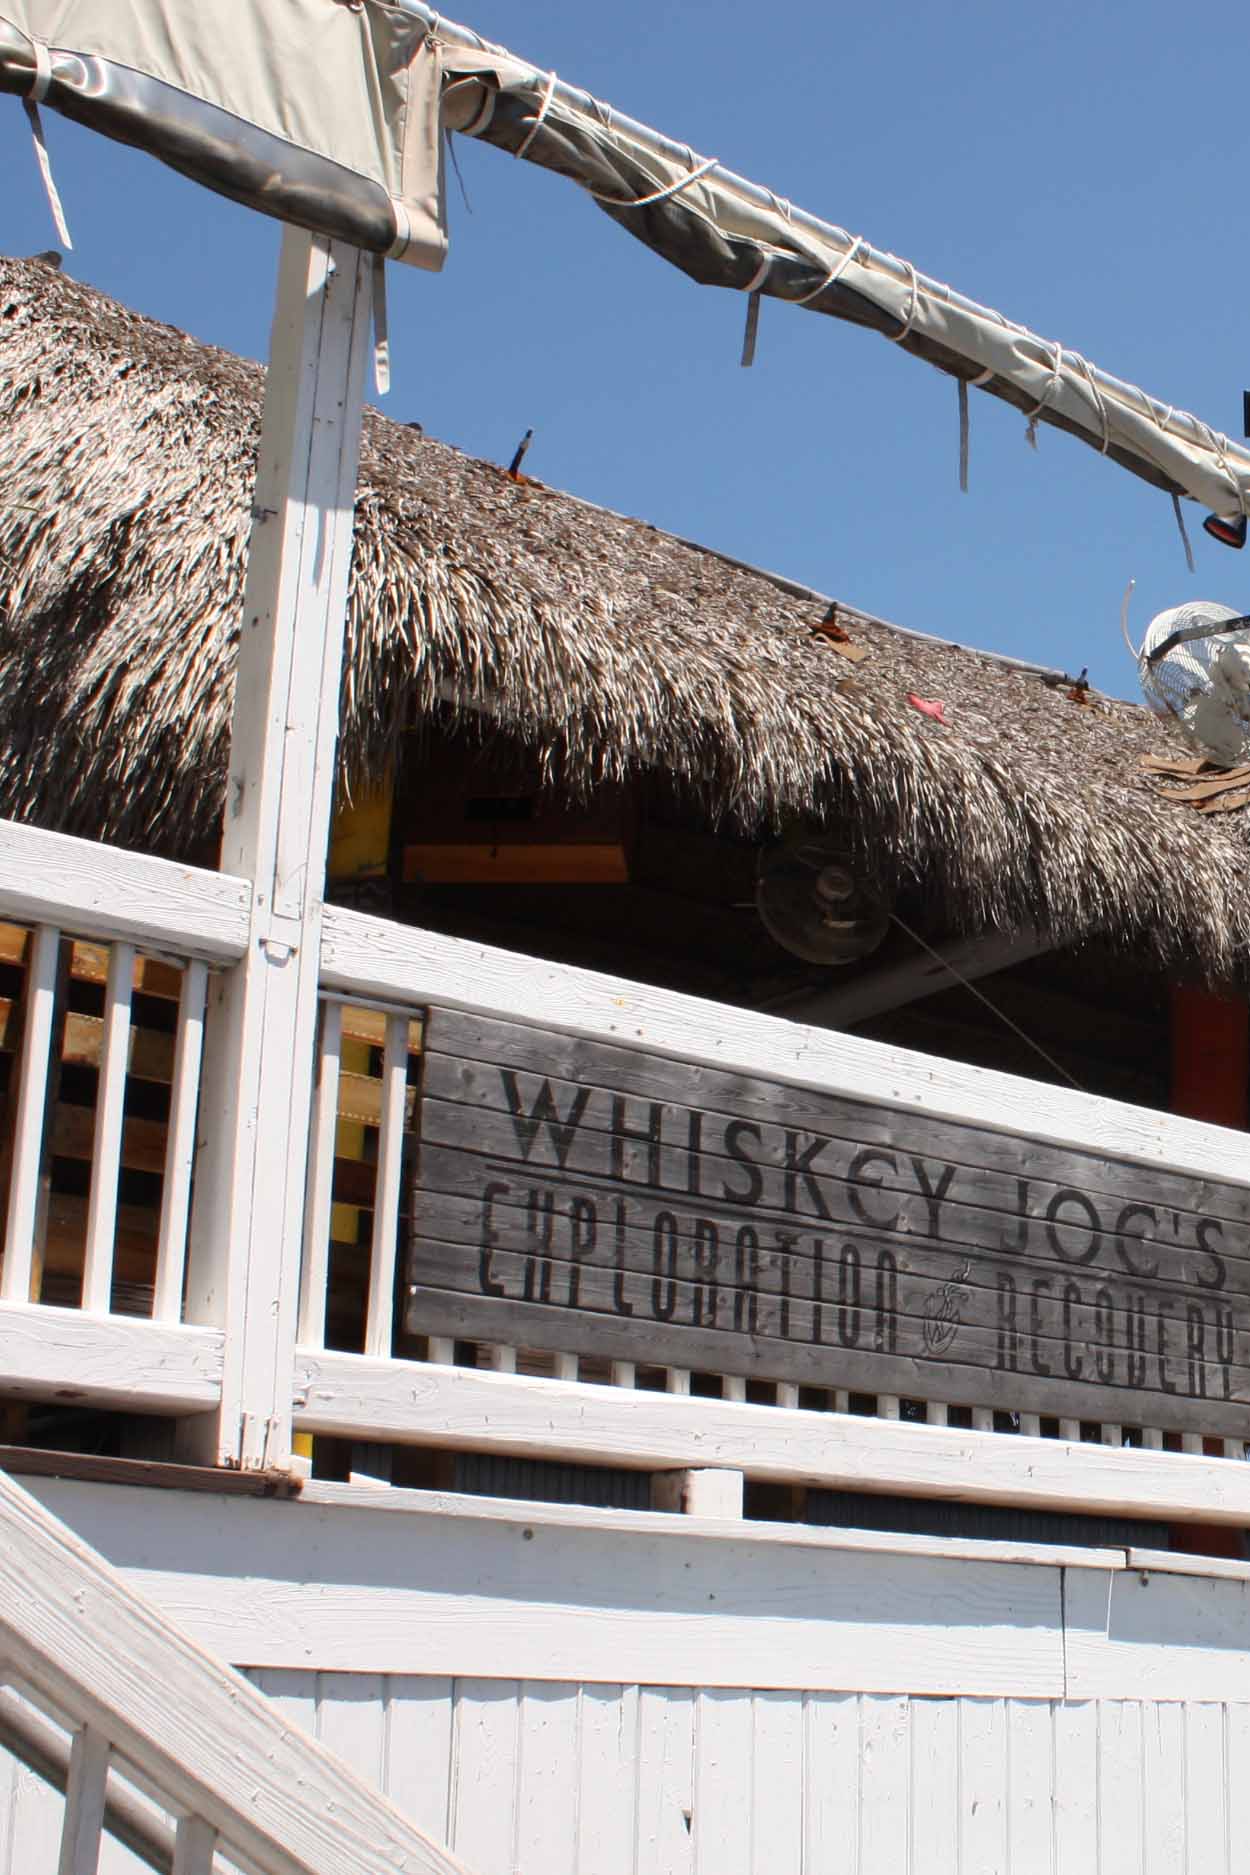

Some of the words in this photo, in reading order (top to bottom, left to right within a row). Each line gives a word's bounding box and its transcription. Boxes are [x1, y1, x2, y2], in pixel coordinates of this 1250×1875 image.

[500, 1069, 958, 1238] WHISKEY
[479, 1183, 897, 1354] EXPLORATION
[997, 1271, 1233, 1400] RECOVERY
